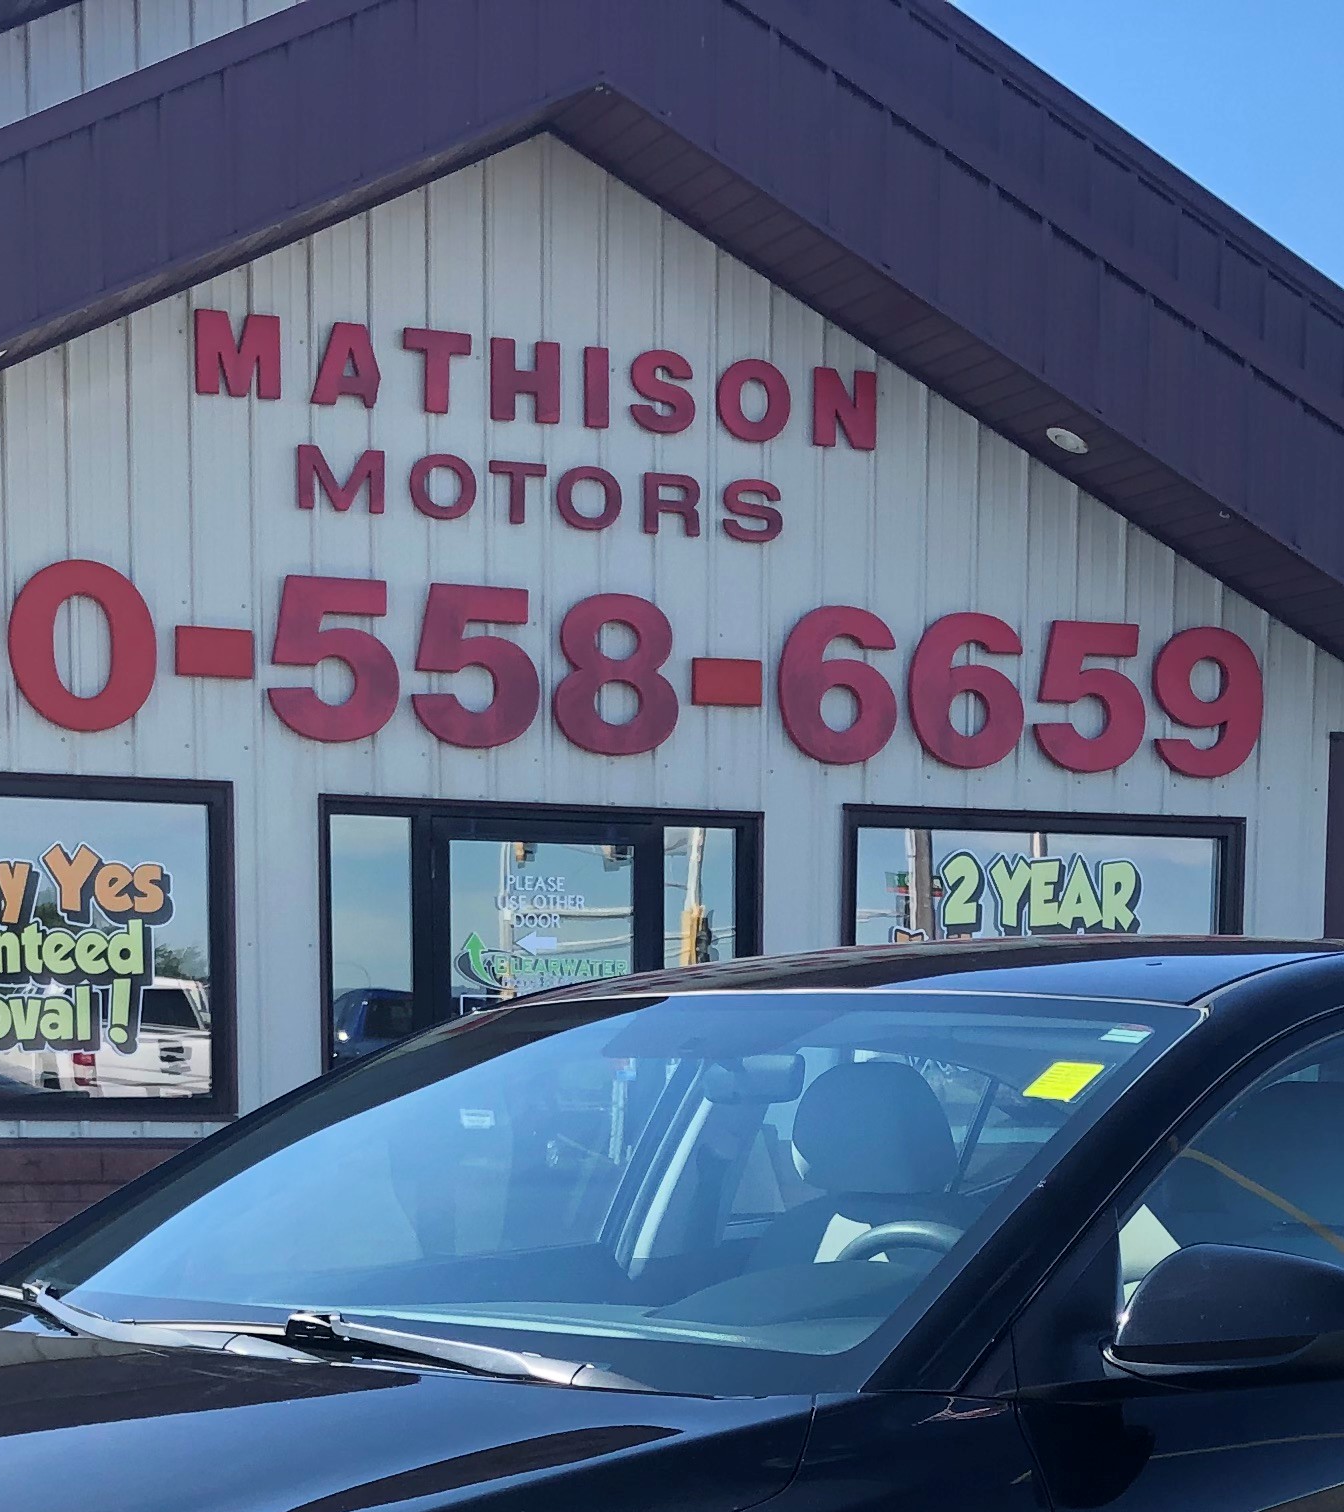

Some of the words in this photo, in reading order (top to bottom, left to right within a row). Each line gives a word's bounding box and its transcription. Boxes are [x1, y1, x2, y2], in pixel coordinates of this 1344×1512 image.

[194, 308, 877, 451] MATHISON
[297, 444, 783, 543] MOTORS
[41, 842, 170, 920] Yes
[496, 895, 528, 910] USE
[532, 894, 586, 910] OTHER
[506, 875, 566, 892] PLEASE
[940, 851, 984, 930] 2
[988, 853, 1140, 931] YEAR
[513, 913, 562, 928] DOOR
